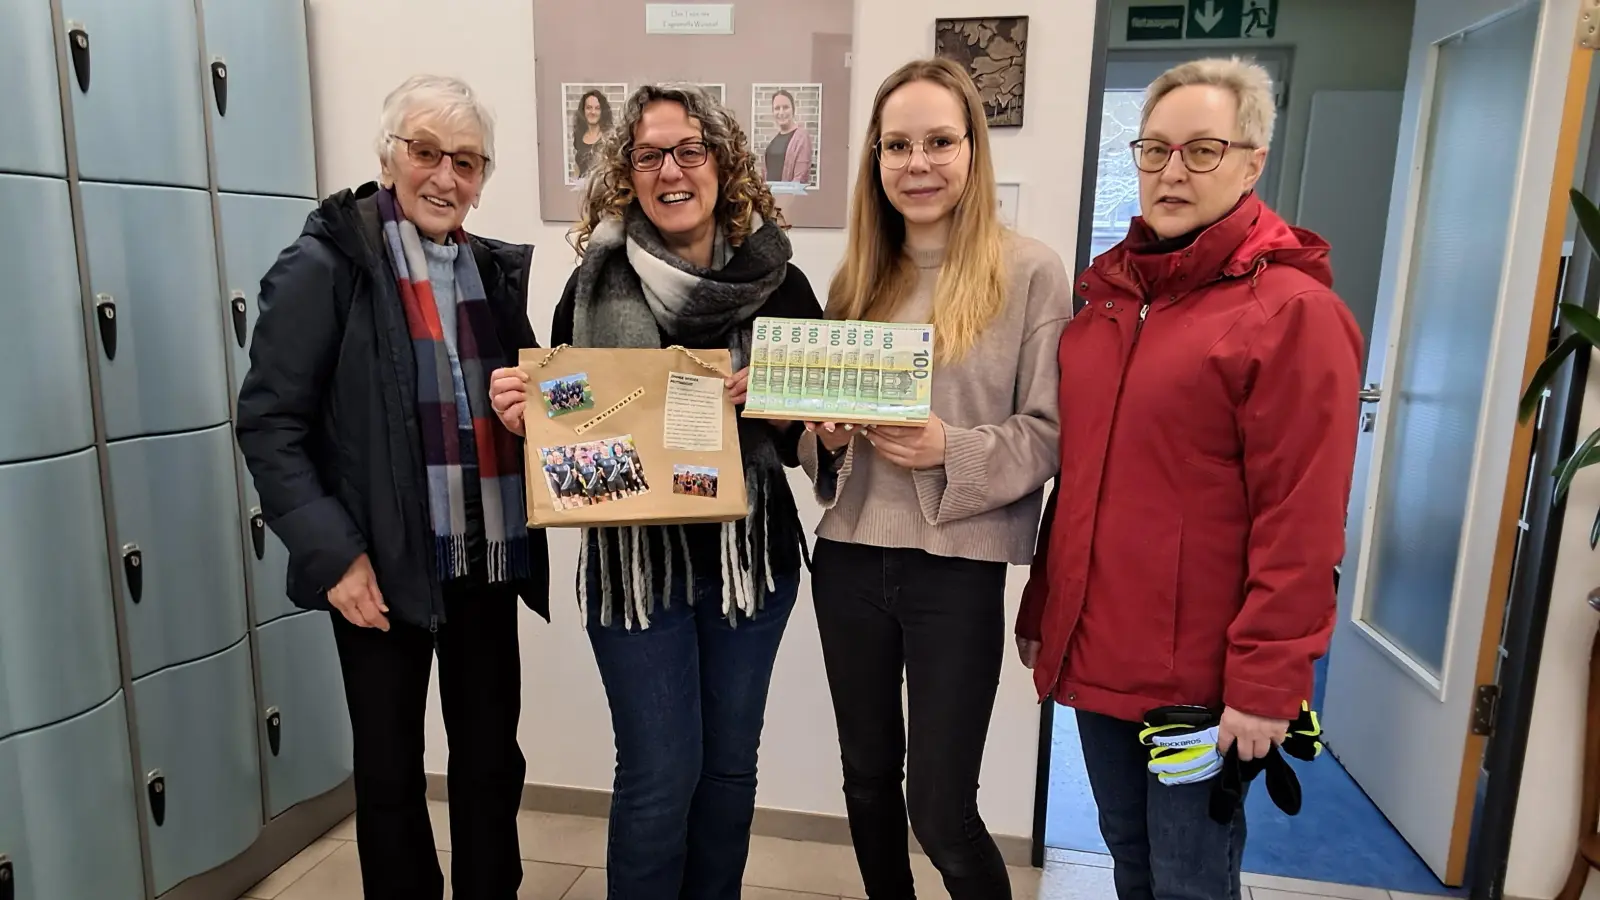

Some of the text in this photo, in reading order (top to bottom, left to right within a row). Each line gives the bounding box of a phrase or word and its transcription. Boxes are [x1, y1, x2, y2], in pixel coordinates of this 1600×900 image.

[757, 324, 767, 340] 100
[772, 325, 782, 342] 100
[791, 326, 801, 343] 100
[808, 327, 818, 344] 100
[830, 329, 841, 346] 100
[846, 328, 857, 345] 100
[863, 329, 874, 346] 100
[883, 332, 893, 349] 100
[913, 349, 929, 379] 100
[1160, 738, 1202, 747] ROCKBROS
